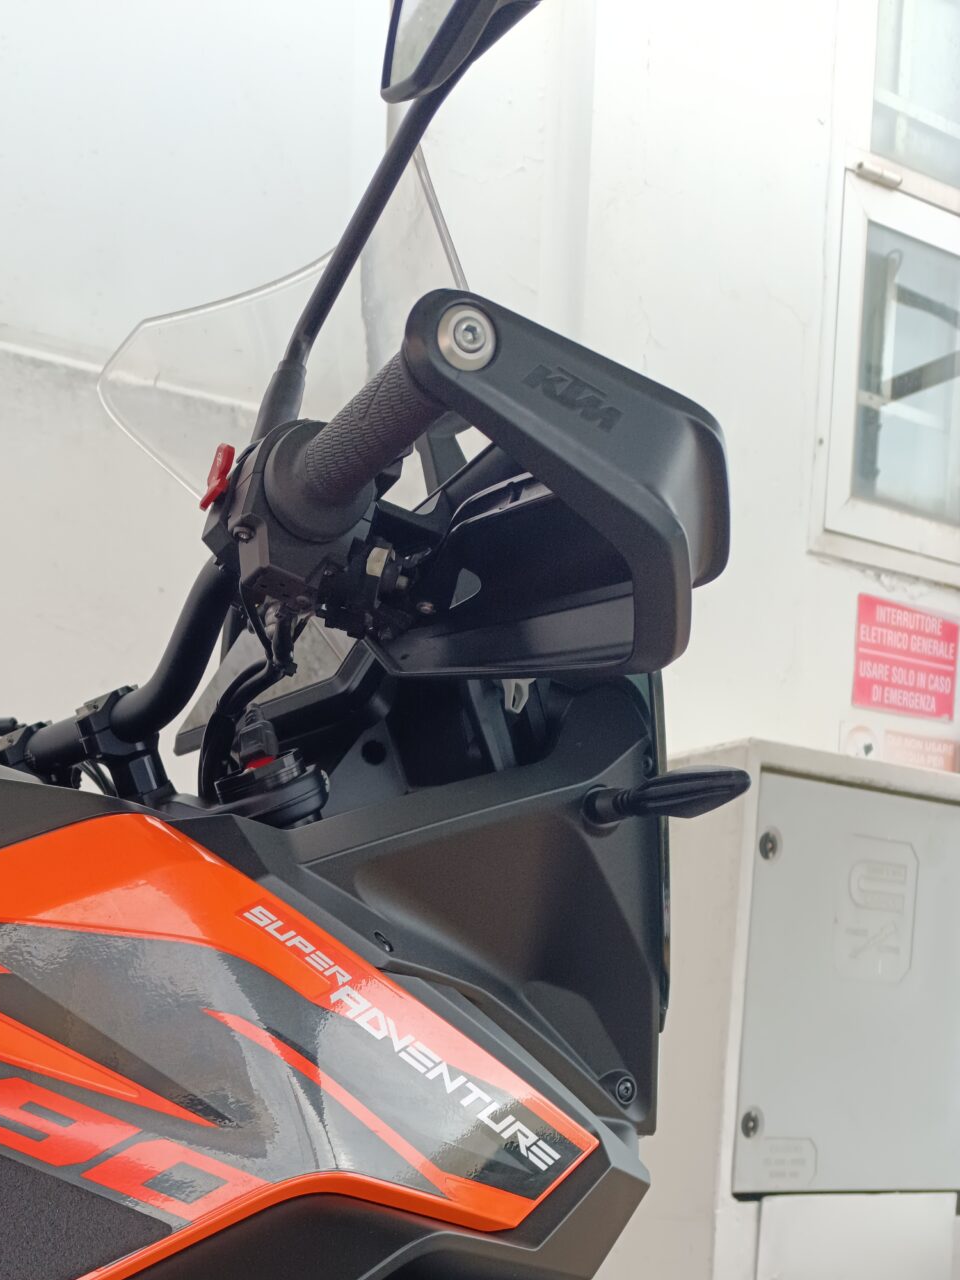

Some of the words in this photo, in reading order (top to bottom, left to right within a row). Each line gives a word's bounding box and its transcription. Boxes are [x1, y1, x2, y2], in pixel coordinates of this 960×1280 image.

[521, 363, 625, 433] KTM
[876, 605, 944, 636] INTERRUTTORE
[859, 624, 909, 650] ELETTRICO
[910, 635, 955, 660] GENERALE
[858, 660, 890, 682] USARE
[891, 666, 915, 686] SOLO
[917, 671, 927, 688] IN
[928, 674, 951, 694] CASO
[871, 684, 882, 702] DI
[884, 687, 936, 713] EMERGENZA
[242, 904, 352, 986] SUPER
[329, 985, 562, 1172] ADVENTURE
